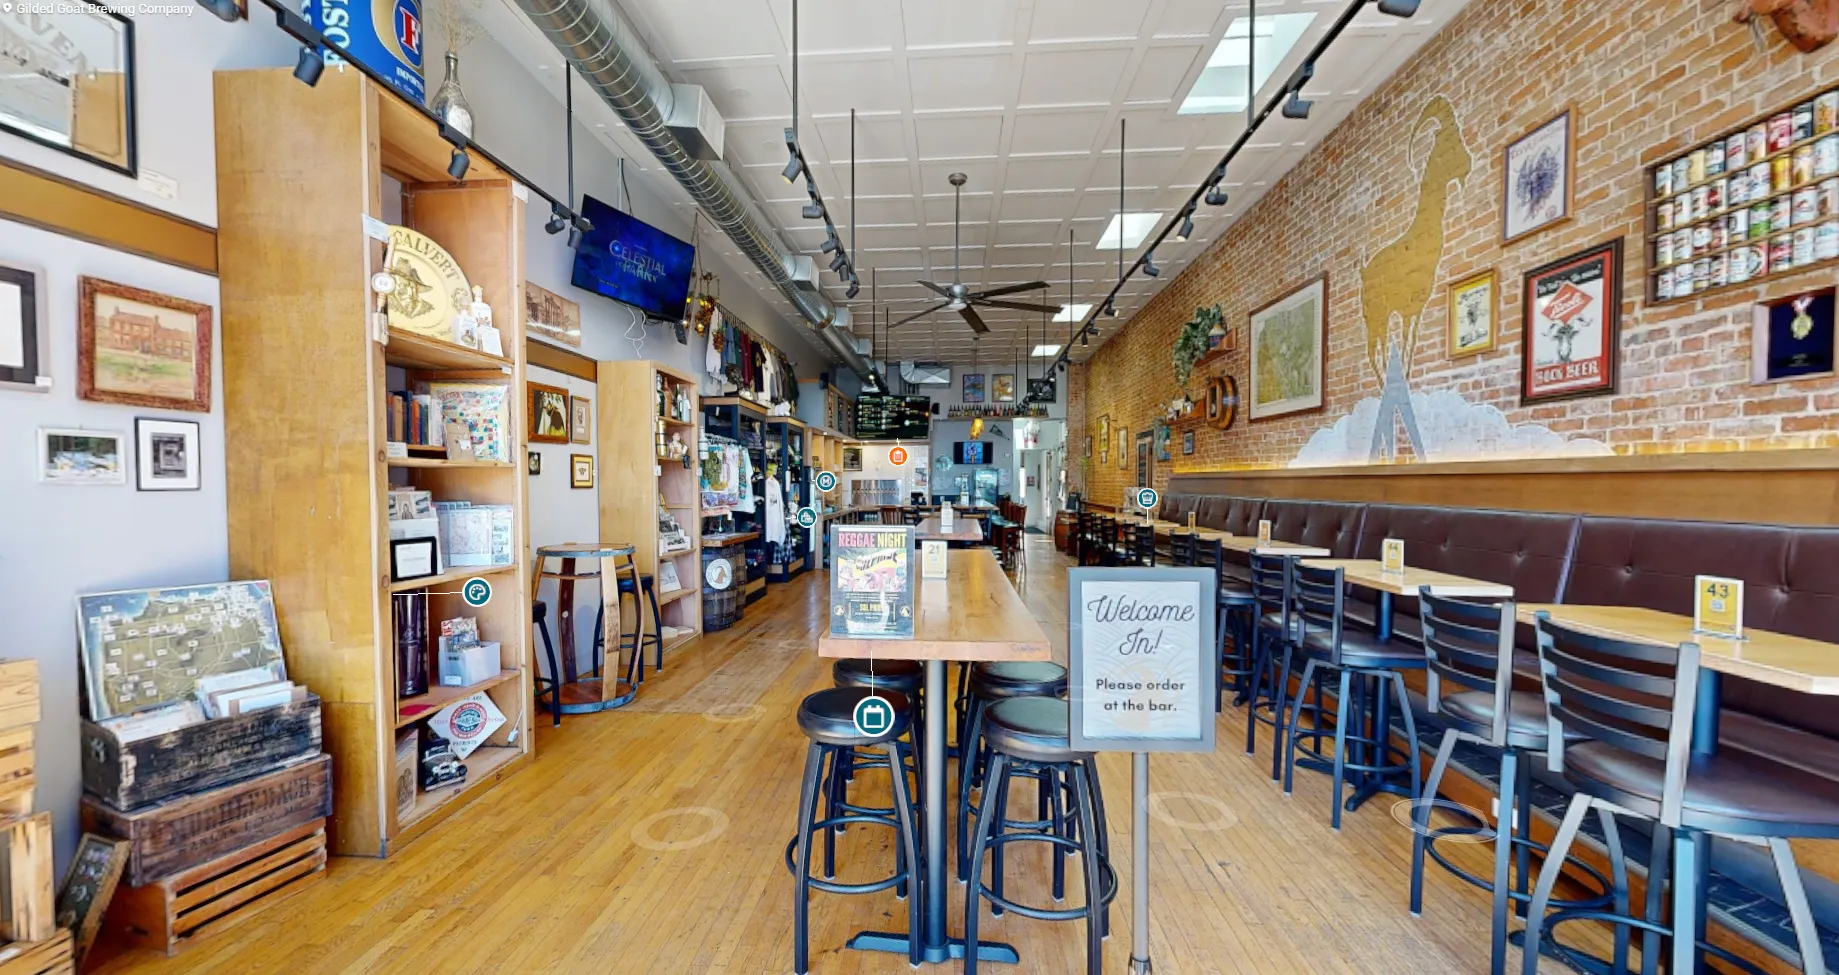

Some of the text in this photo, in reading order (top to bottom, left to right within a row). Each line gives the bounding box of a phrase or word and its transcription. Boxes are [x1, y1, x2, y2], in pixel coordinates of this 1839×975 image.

[400, 6, 420, 55] F
[392, 230, 460, 281] CALVERT
[609, 239, 667, 277] CELESTIAL
[1566, 360, 1599, 378] BEER
[838, 532, 907, 548] REGGAE NIGHT
[928, 544, 940, 555] 21
[1706, 582, 1728, 599] 43
[1087, 594, 1195, 623] Welcome
[1119, 627, 1164, 656] In!
[1095, 678, 1186, 690] Please order
[1104, 698, 1178, 711] at the bar.
